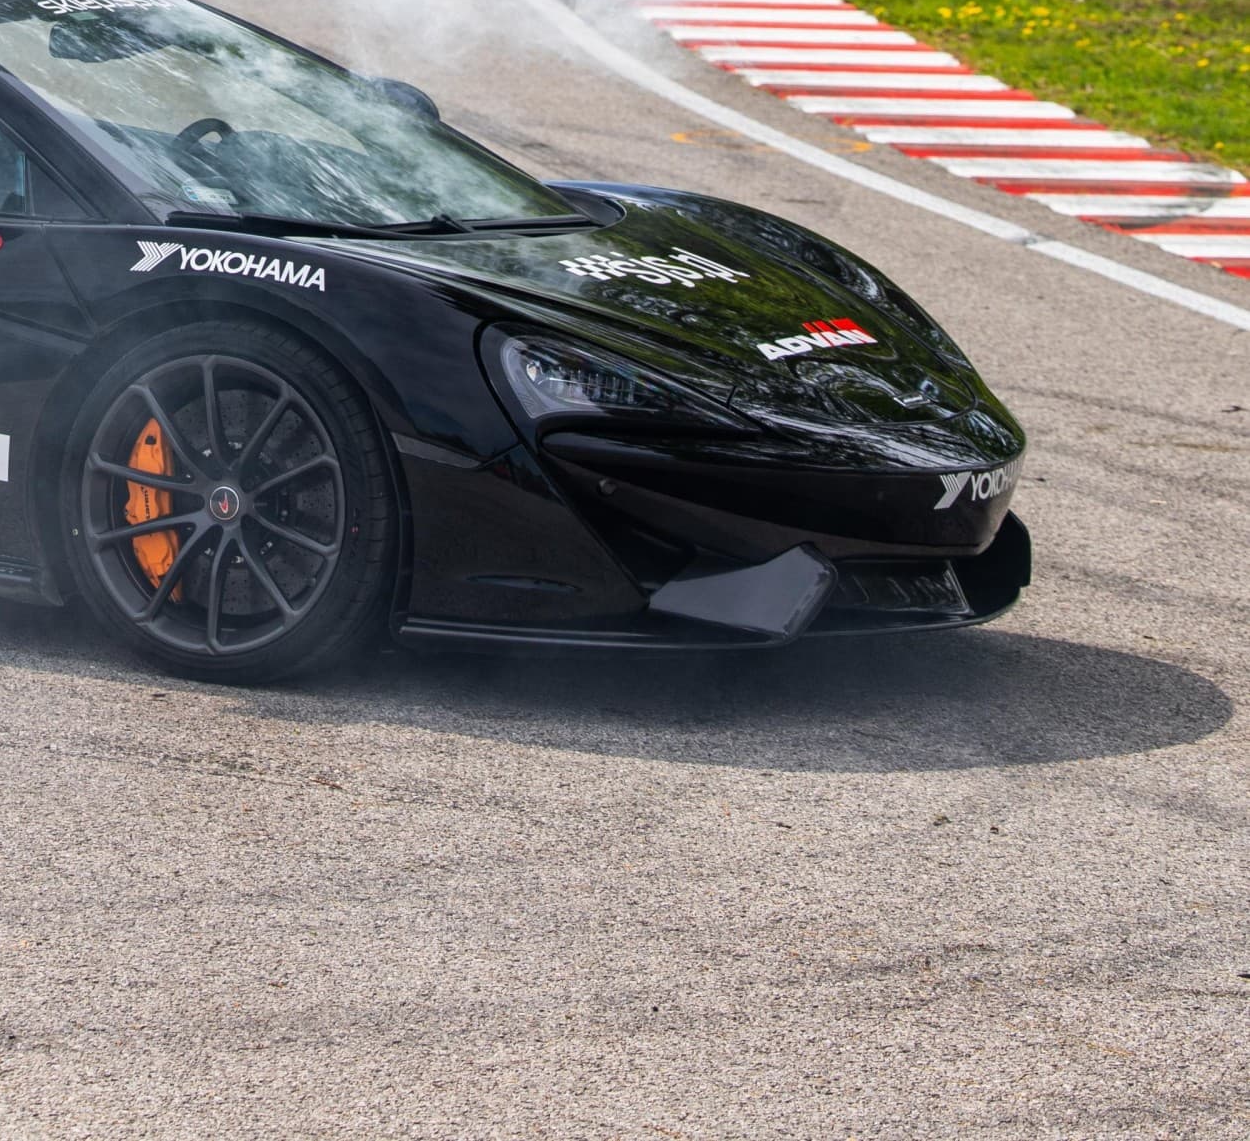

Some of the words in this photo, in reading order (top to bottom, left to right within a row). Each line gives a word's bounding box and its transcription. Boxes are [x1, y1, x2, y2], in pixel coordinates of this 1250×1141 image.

[179, 246, 326, 292] YOKOHAMA
[606, 246, 751, 288] sjs.pl
[756, 328, 878, 361] ADVAN
